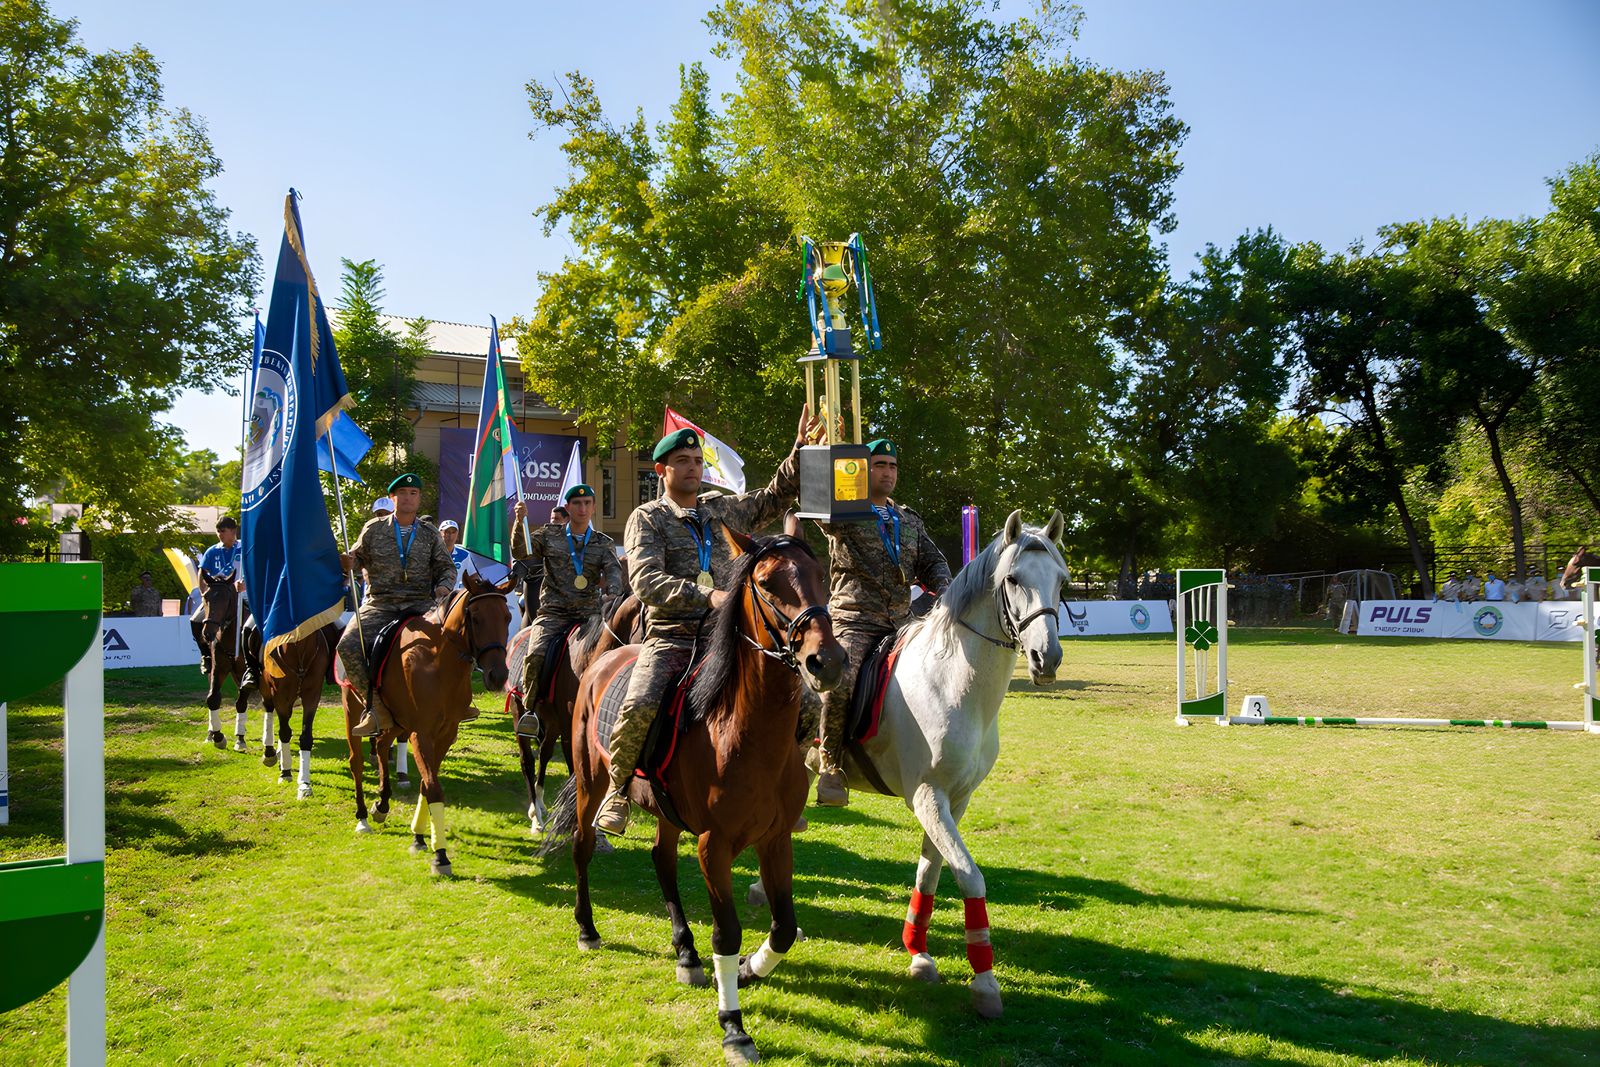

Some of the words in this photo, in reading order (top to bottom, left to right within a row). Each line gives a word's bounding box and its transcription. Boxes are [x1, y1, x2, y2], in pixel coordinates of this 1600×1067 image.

[521, 461, 561, 479] OSS
[1369, 606, 1433, 624] PULS
[1253, 701, 1262, 717] 3
